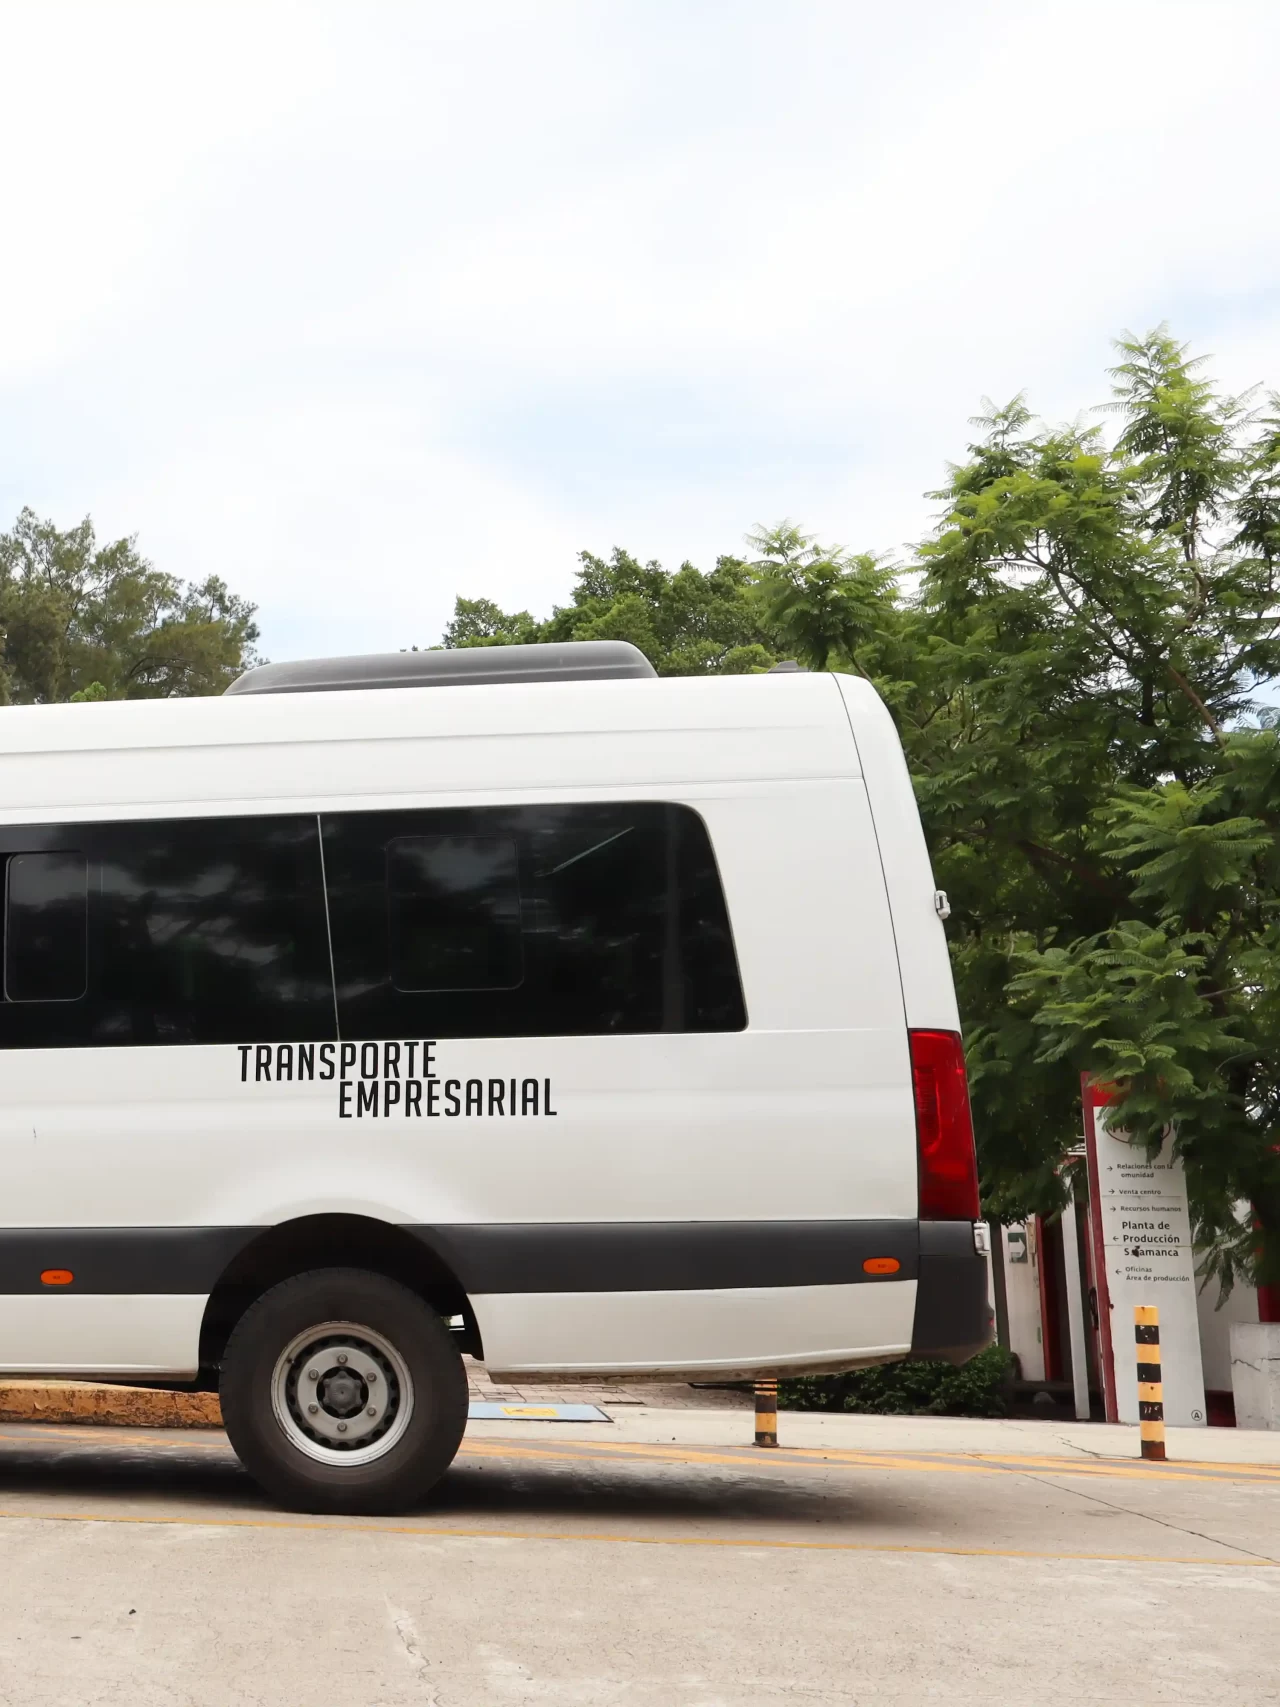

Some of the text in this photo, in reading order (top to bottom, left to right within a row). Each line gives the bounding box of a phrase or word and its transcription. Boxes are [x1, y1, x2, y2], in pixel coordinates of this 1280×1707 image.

[237, 1041, 437, 1082] TRANSPORTE
[338, 1078, 558, 1118] EMPRESARIAL
[1122, 1221, 1170, 1230] Planta de
[1123, 1234, 1181, 1244] Producción
[1124, 1247, 1180, 1257] Samanca
